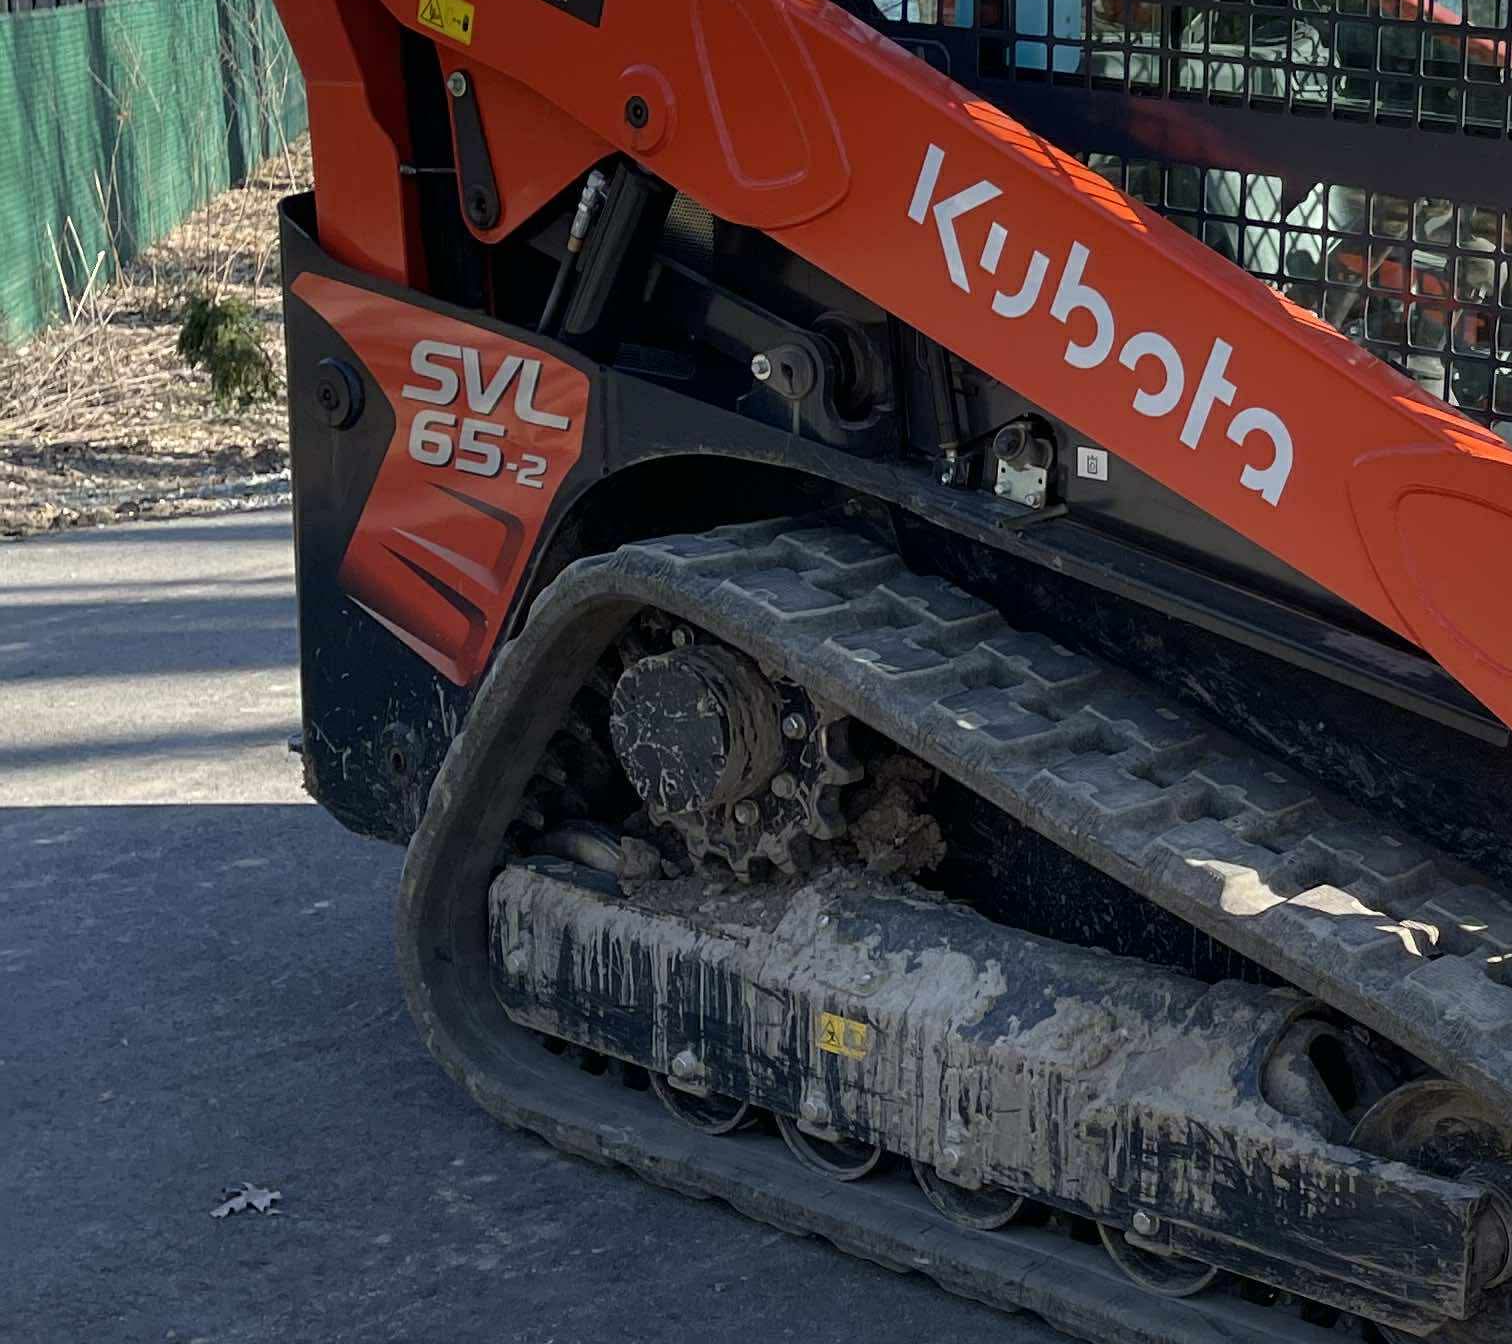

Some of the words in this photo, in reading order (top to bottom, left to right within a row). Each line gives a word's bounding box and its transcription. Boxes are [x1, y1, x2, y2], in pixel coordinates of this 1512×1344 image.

[908, 143, 1294, 507] Kubota
[401, 339, 570, 431] SVL
[408, 409, 547, 489] 65-2
